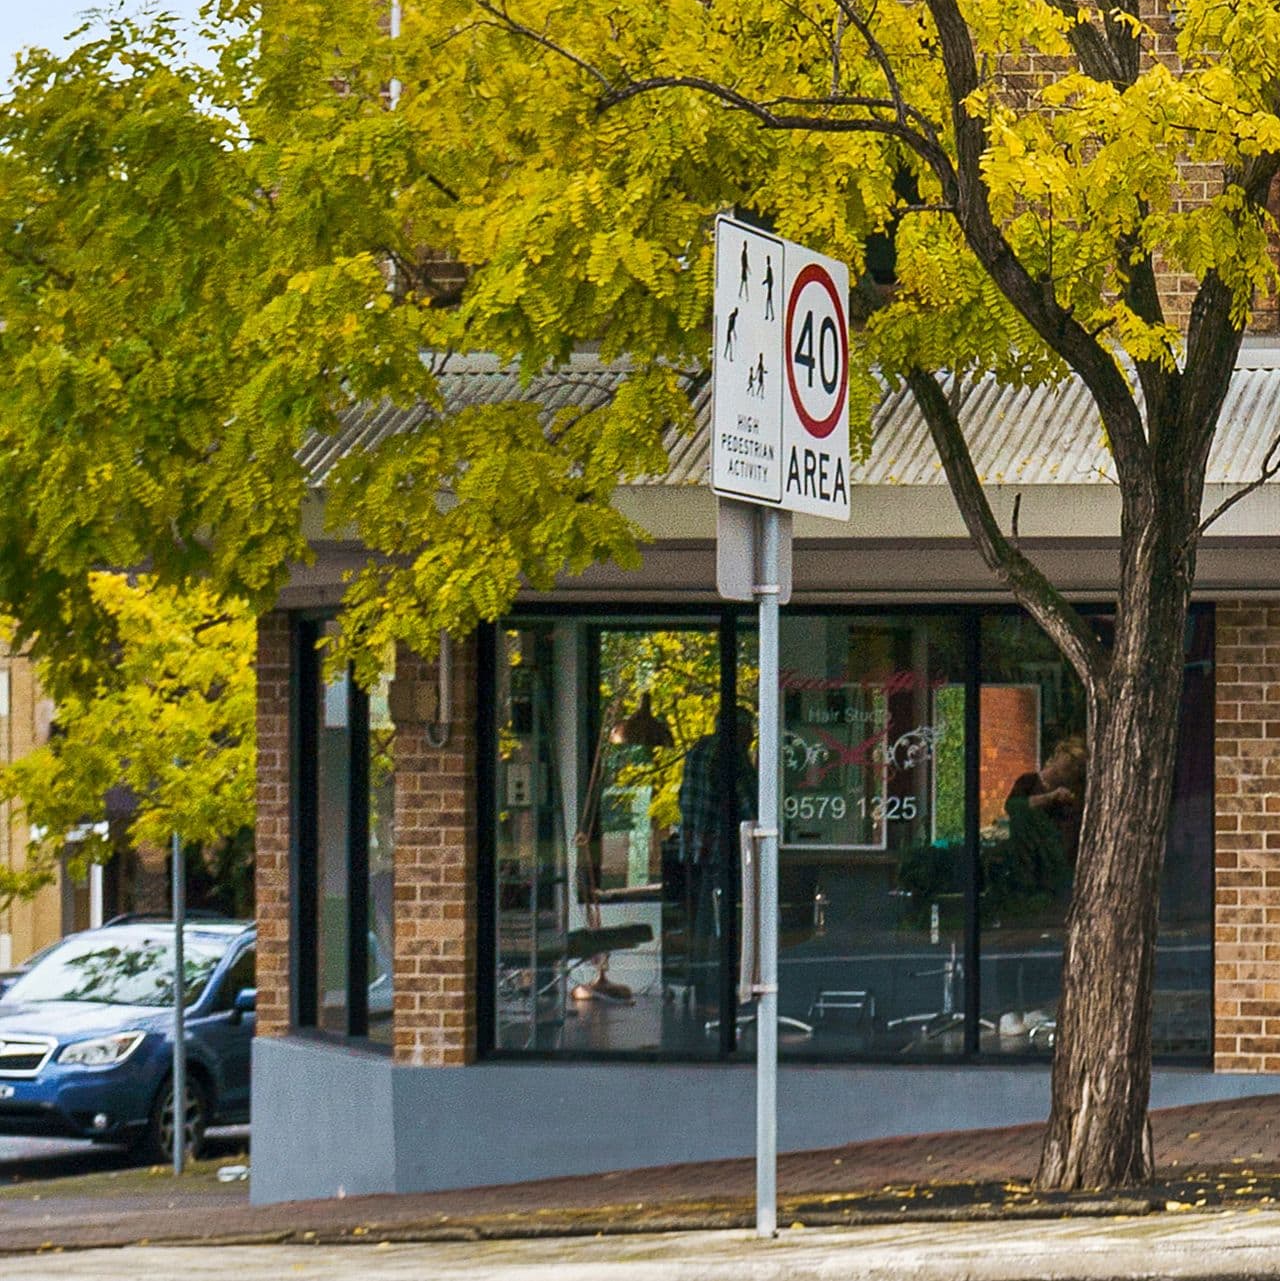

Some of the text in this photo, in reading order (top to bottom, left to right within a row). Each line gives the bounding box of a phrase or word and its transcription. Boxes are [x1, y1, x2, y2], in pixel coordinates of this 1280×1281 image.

[794, 310, 839, 395] 40
[737, 414, 760, 434] HIGH
[720, 432, 775, 461] PEDESTRIAN
[727, 458, 769, 483] ACTIVITY
[786, 444, 848, 506] AREA
[783, 796, 846, 819] 9579
